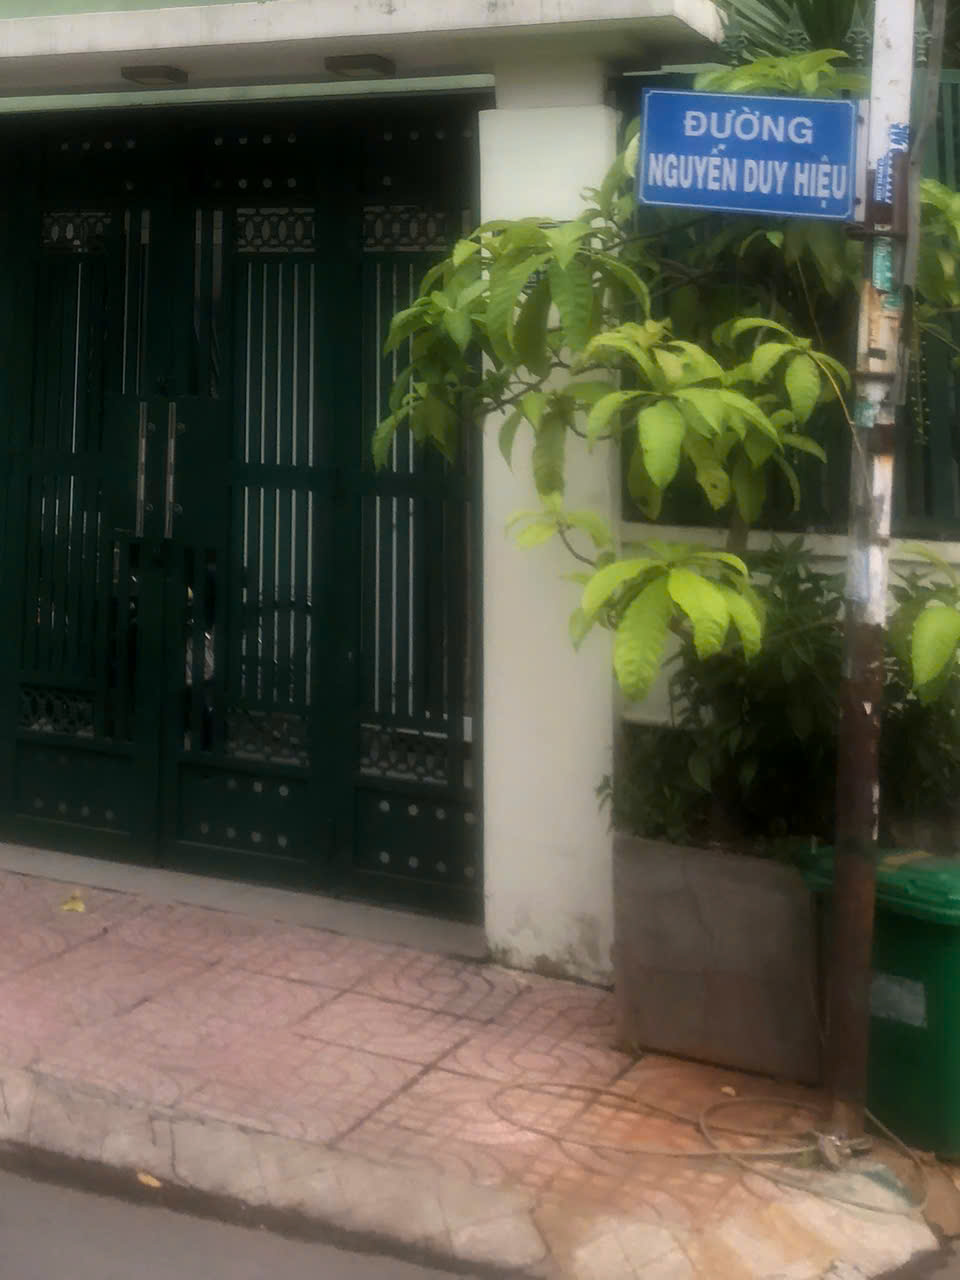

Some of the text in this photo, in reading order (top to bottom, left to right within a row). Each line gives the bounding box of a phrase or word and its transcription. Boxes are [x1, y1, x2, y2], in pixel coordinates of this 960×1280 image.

[683, 106, 814, 144] ĐƯỜNG
[648, 144, 737, 192] NGUYỄN
[743, 158, 788, 195] DUY
[793, 155, 848, 209] HIỆU
